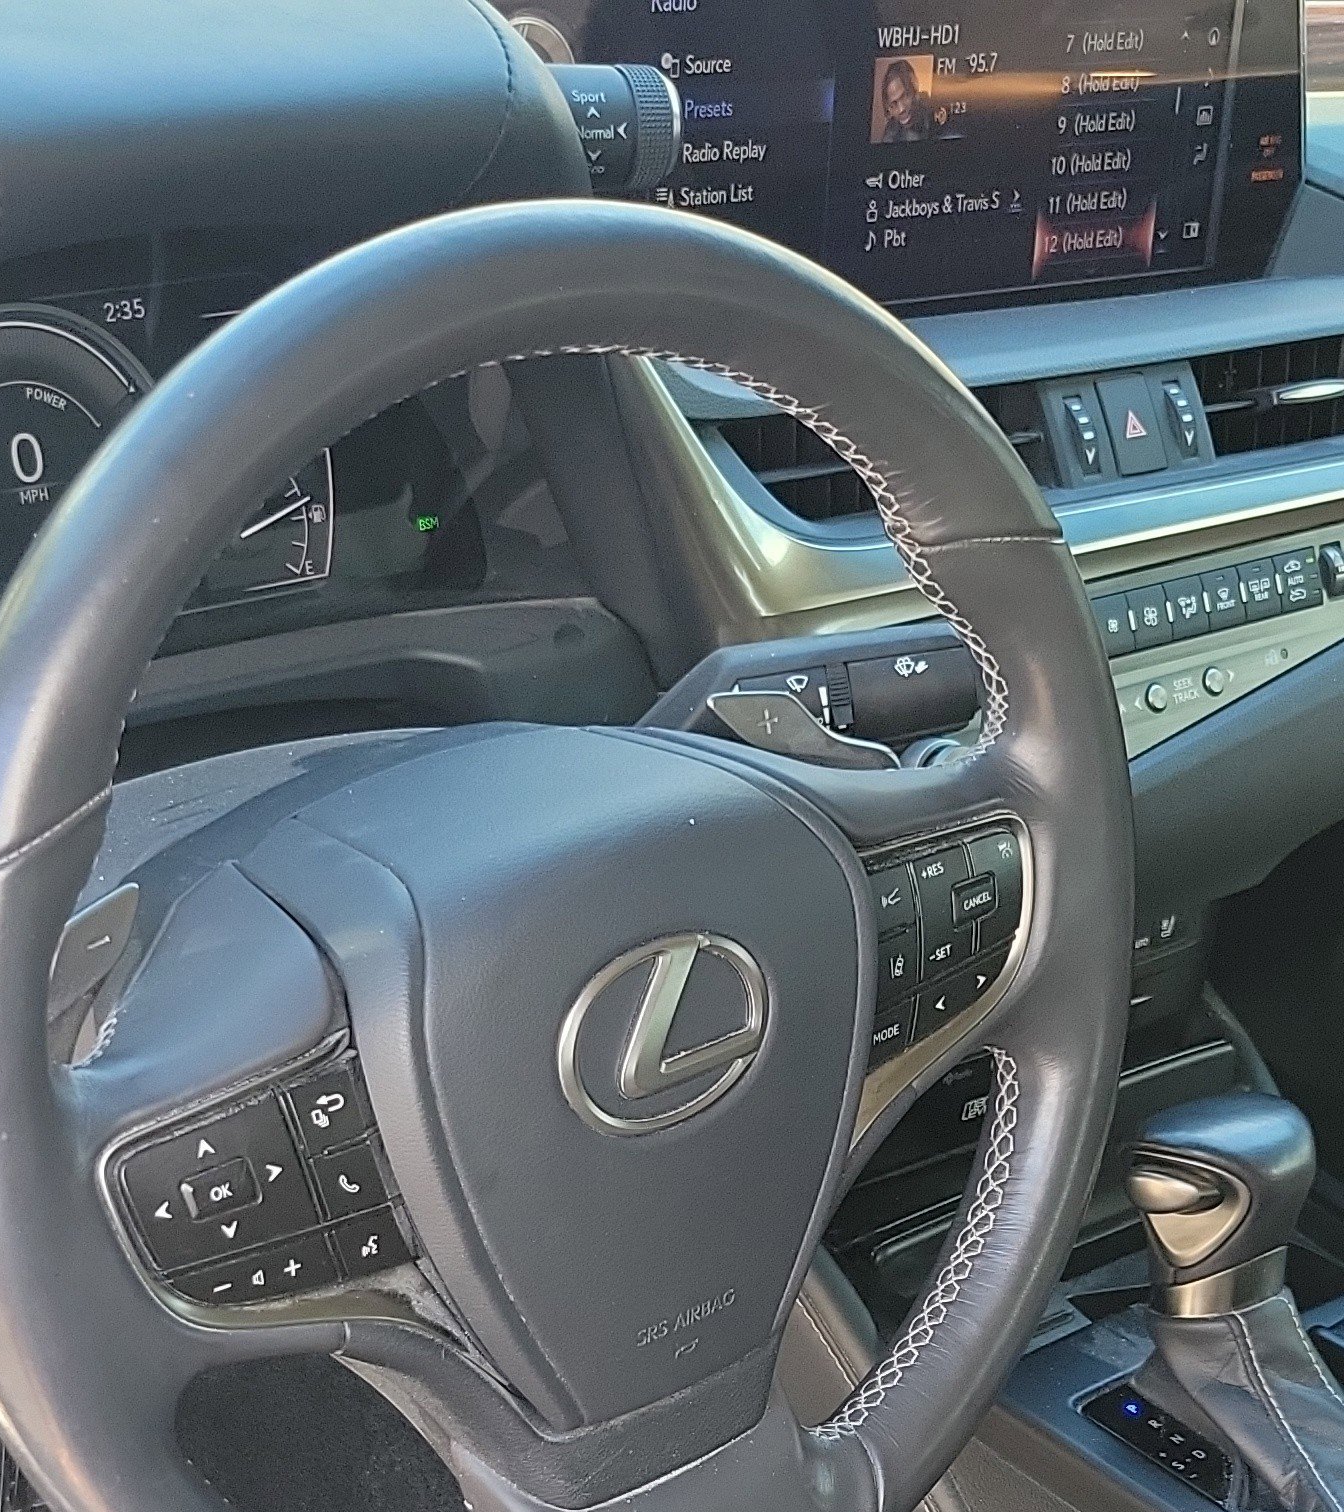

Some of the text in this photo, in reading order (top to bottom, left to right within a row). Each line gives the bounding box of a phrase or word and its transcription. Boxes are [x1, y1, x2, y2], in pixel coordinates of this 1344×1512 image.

[877, 24, 960, 48] WBHJ-HD1
[1066, 29, 1144, 54] 7 (Hold Edit)
[685, 54, 732, 75] Source
[937, 58, 956, 75] FM
[1061, 74, 1140, 95] 8 (Hold Edit)
[571, 90, 607, 105] Sport
[684, 99, 733, 119] Presets
[1057, 109, 1136, 135] 9 (Hold Edit)
[682, 139, 766, 164] Radio Replay
[1051, 148, 1132, 175] 10 (Hold Edit)
[888, 170, 925, 190] Other
[680, 183, 754, 207] Station List
[885, 191, 1001, 219] Jackboys & Travis S
[1048, 187, 1127, 215] 11 (Hold Edit)
[1045, 226, 1123, 253] 12 (Hold Edit)
[103, 298, 146, 323] 2:35
[26, 387, 67, 412] POWER
[11, 433, 44, 483] 0
[19, 487, 50, 505] MPH
[418, 516, 440, 531] BSM
[305, 561, 314, 576] E
[1287, 575, 1304, 586] AUTO
[1172, 689, 1200, 705] TRACK
[963, 891, 992, 911] CANCEL
[872, 1024, 900, 1046] MODE
[209, 1183, 234, 1201] OK
[636, 1288, 736, 1347] SRS AIRBAG
[1147, 1419, 1163, 1429] R
[1169, 1433, 1185, 1445] N
[1191, 1449, 1206, 1460] D
[1171, 1461, 1186, 1471] S
